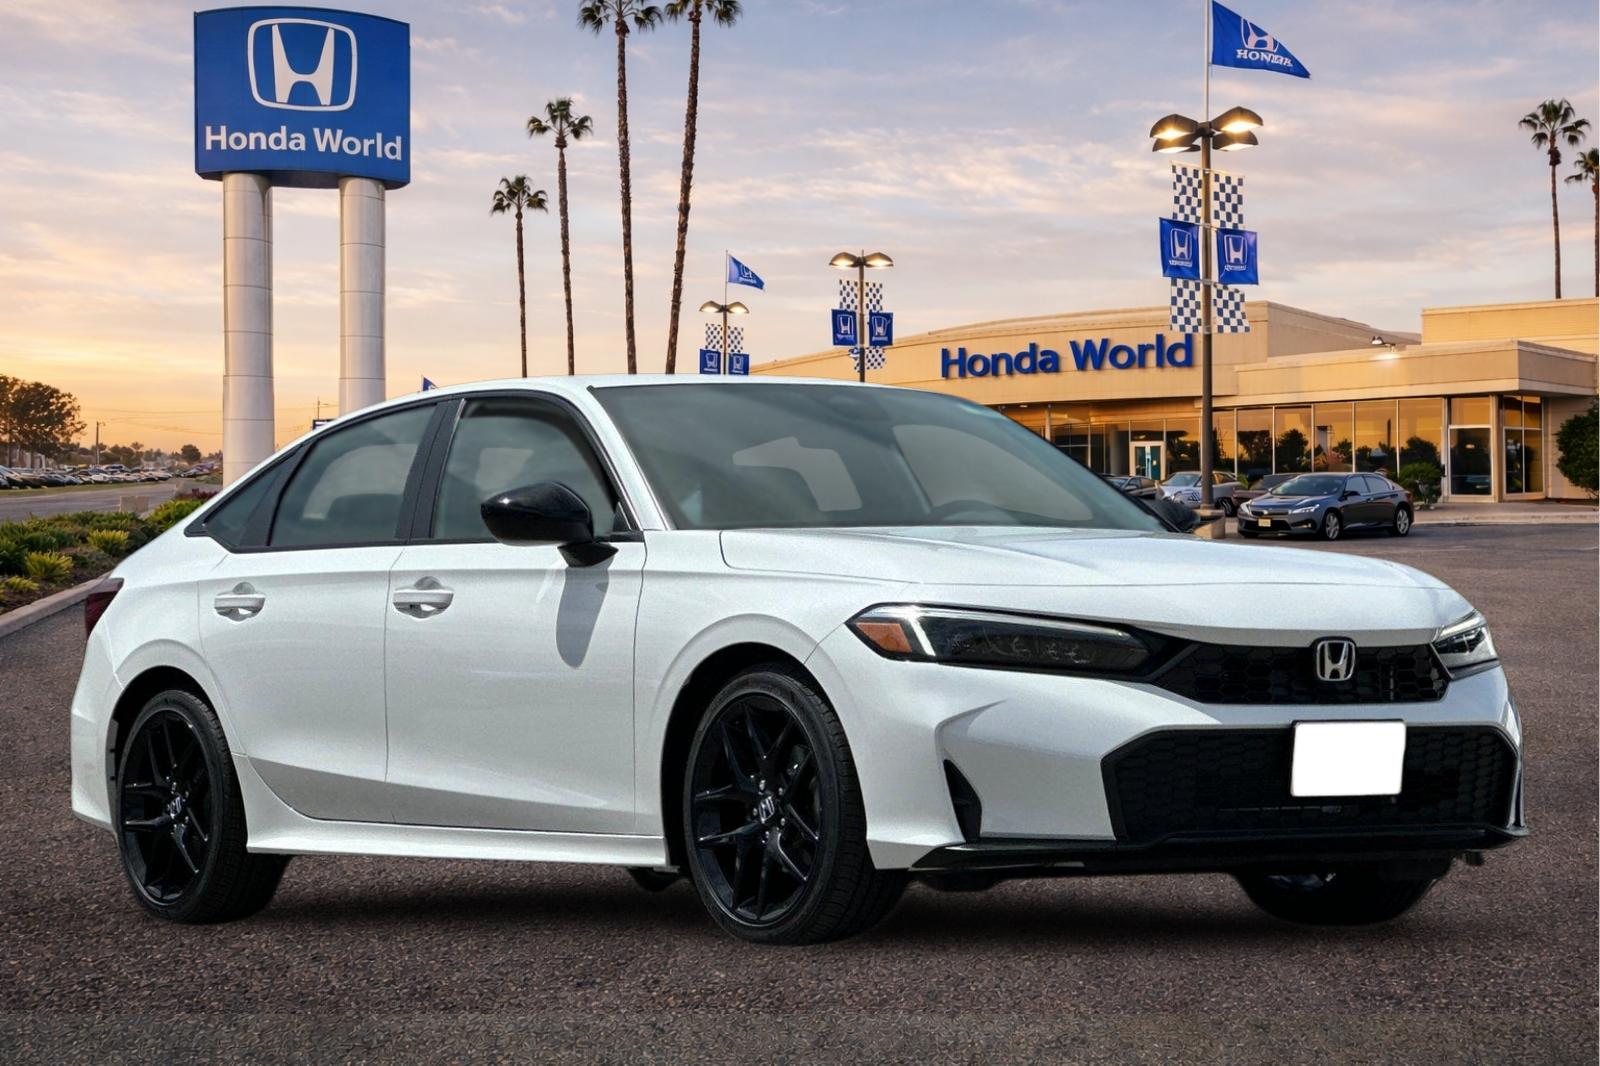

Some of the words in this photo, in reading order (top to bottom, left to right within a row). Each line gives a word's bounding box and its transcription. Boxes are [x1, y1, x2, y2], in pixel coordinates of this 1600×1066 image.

[205, 125, 306, 151] Honda
[313, 127, 402, 161] World
[941, 342, 1061, 379] Honda
[1069, 333, 1194, 372] World
